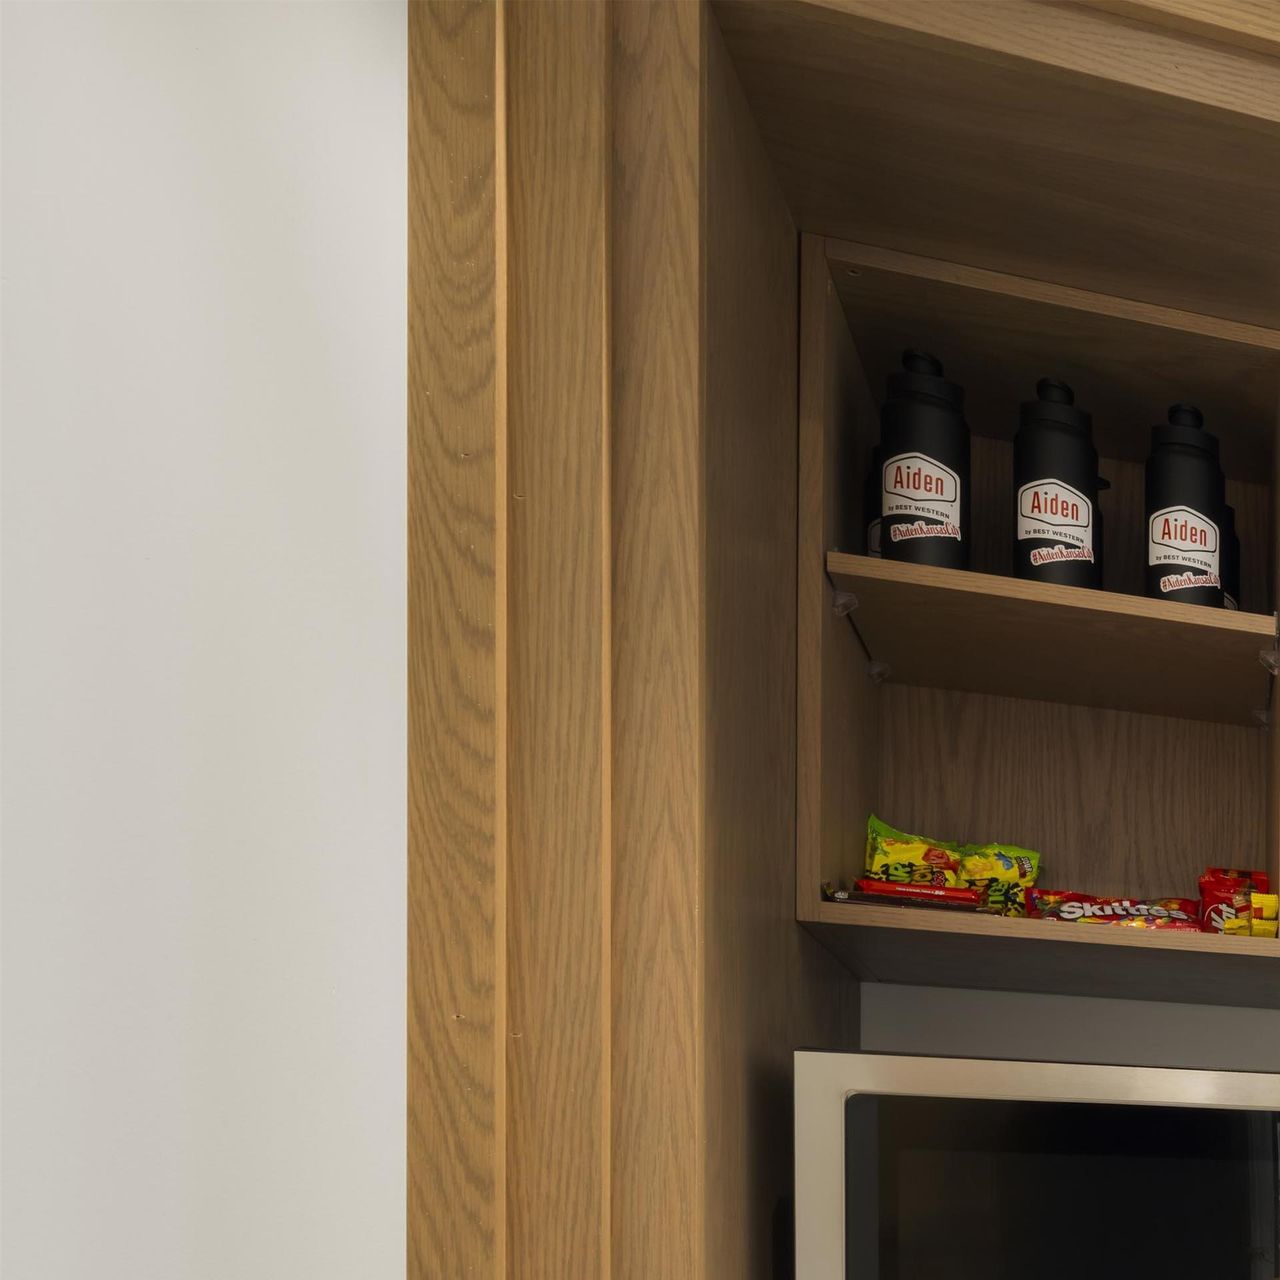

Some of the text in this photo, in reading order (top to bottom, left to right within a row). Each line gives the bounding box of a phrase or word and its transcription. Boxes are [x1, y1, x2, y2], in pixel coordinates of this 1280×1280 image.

[894, 465, 944, 496] Aiden
[915, 506, 950, 519] WESTERN
[1031, 491, 1079, 521] Aiden
[1053, 530, 1084, 543] WESTERN
[1161, 518, 1207, 547] Aiden
[1182, 557, 1211, 568] WESTERN
